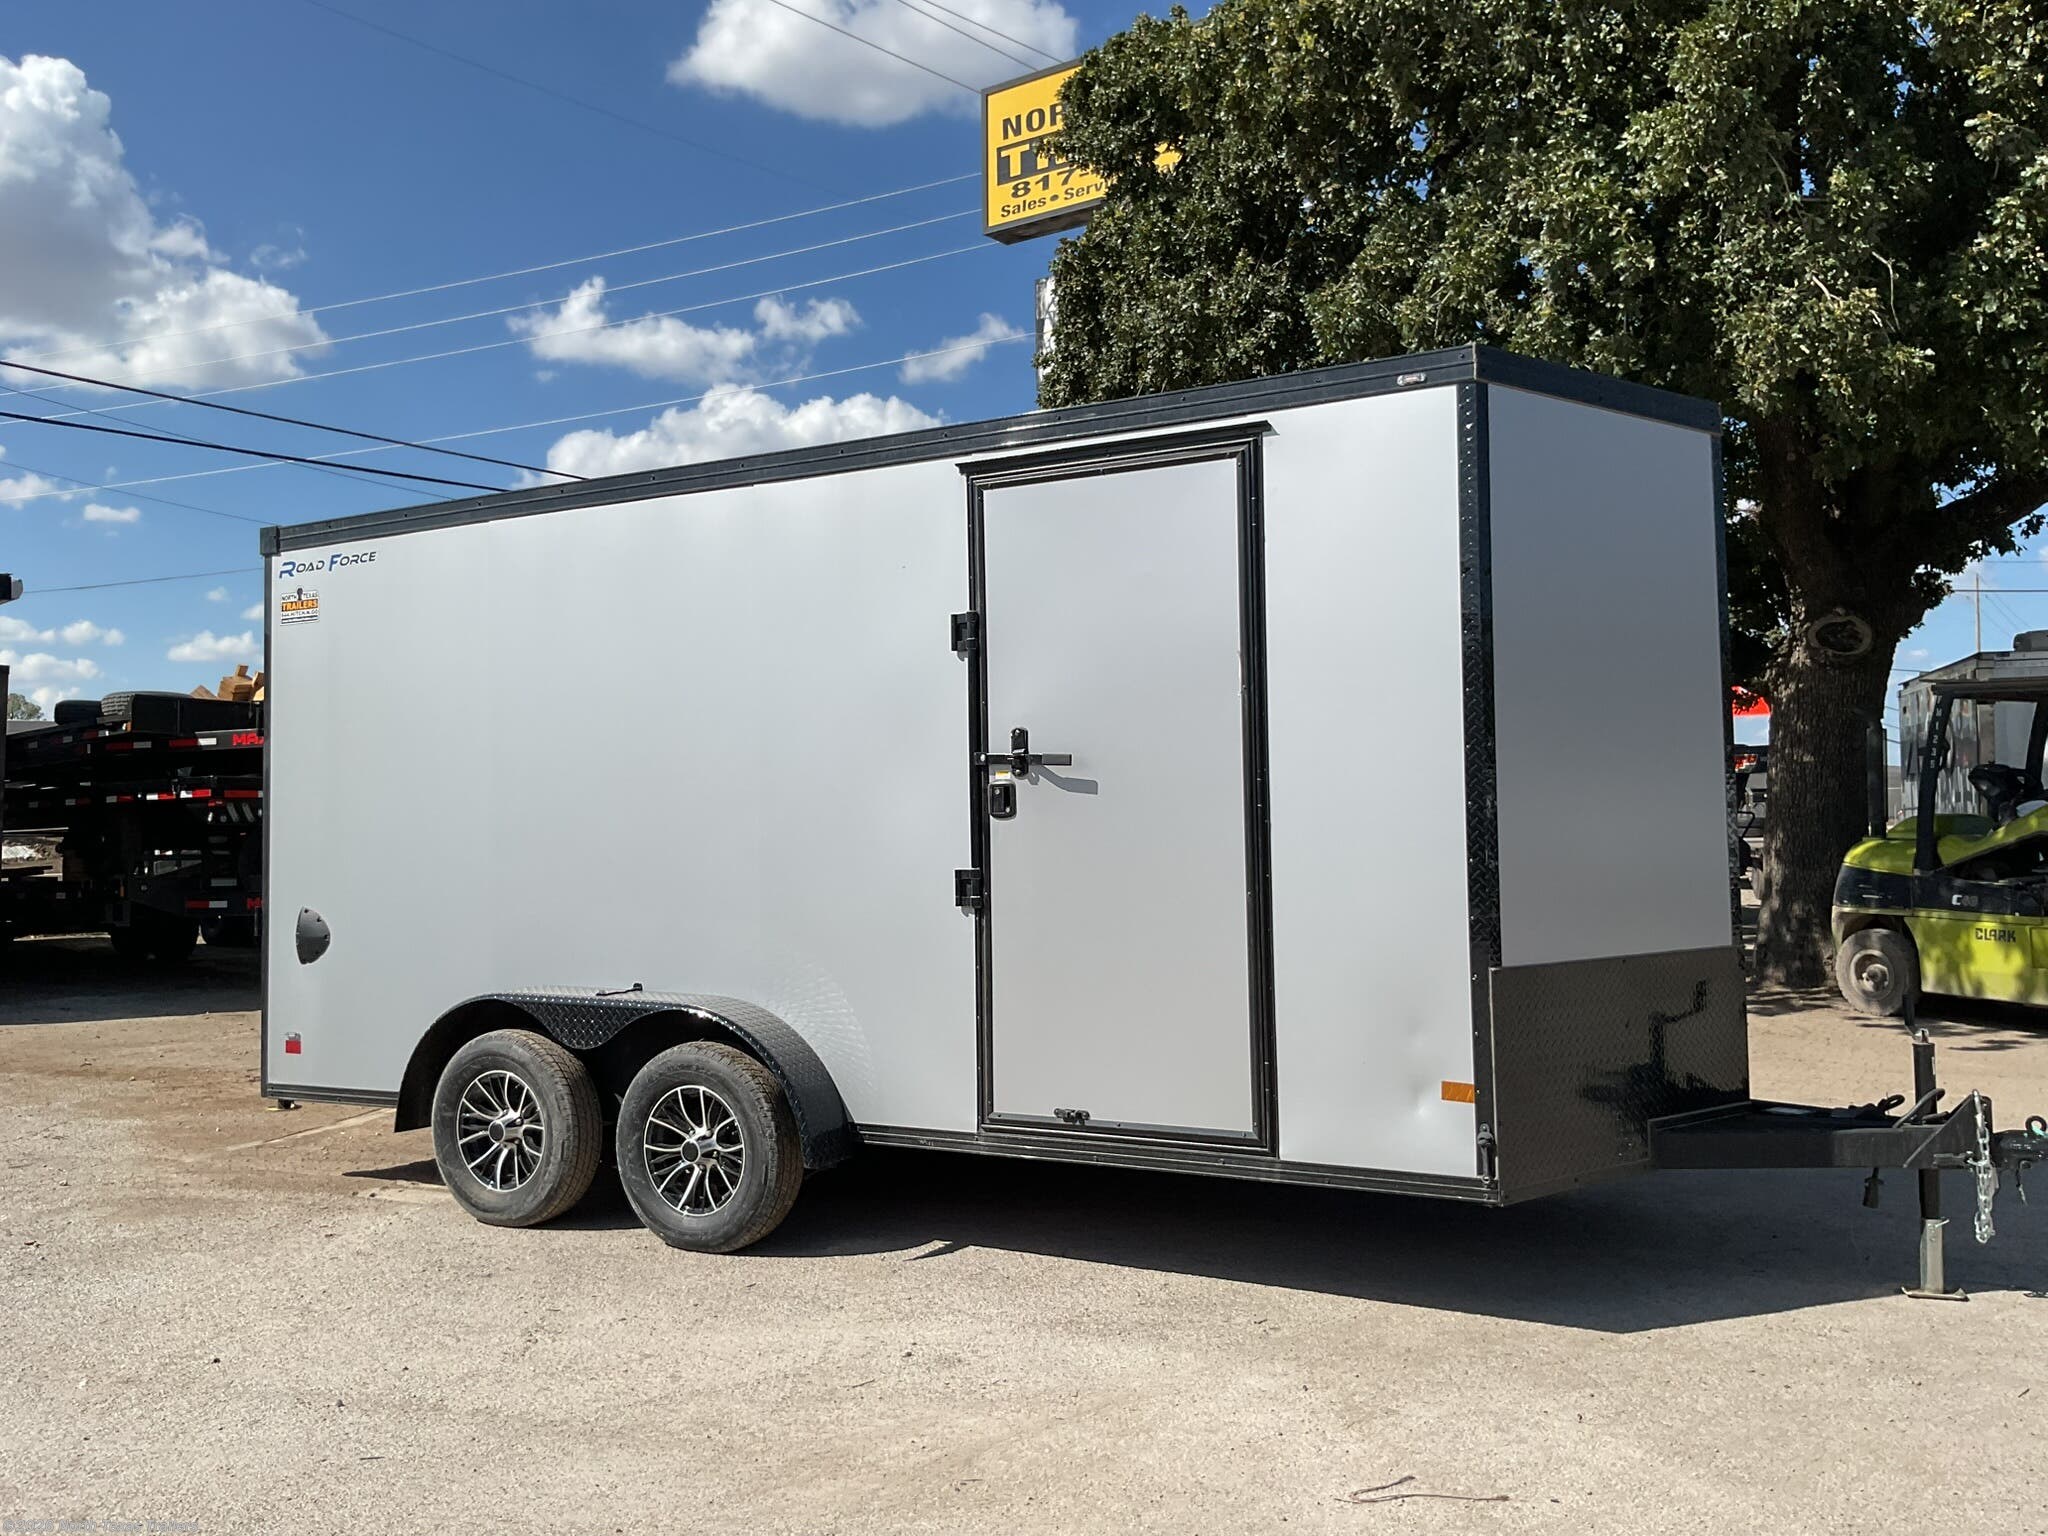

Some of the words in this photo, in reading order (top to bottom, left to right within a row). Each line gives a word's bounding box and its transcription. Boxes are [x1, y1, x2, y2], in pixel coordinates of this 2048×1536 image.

[1001, 197, 1046, 218] Sales
[279, 560, 325, 579] ROAD
[329, 552, 376, 572] FORCE
[282, 600, 317, 611] TRAILERS
[1975, 927, 2016, 943] CLARK
